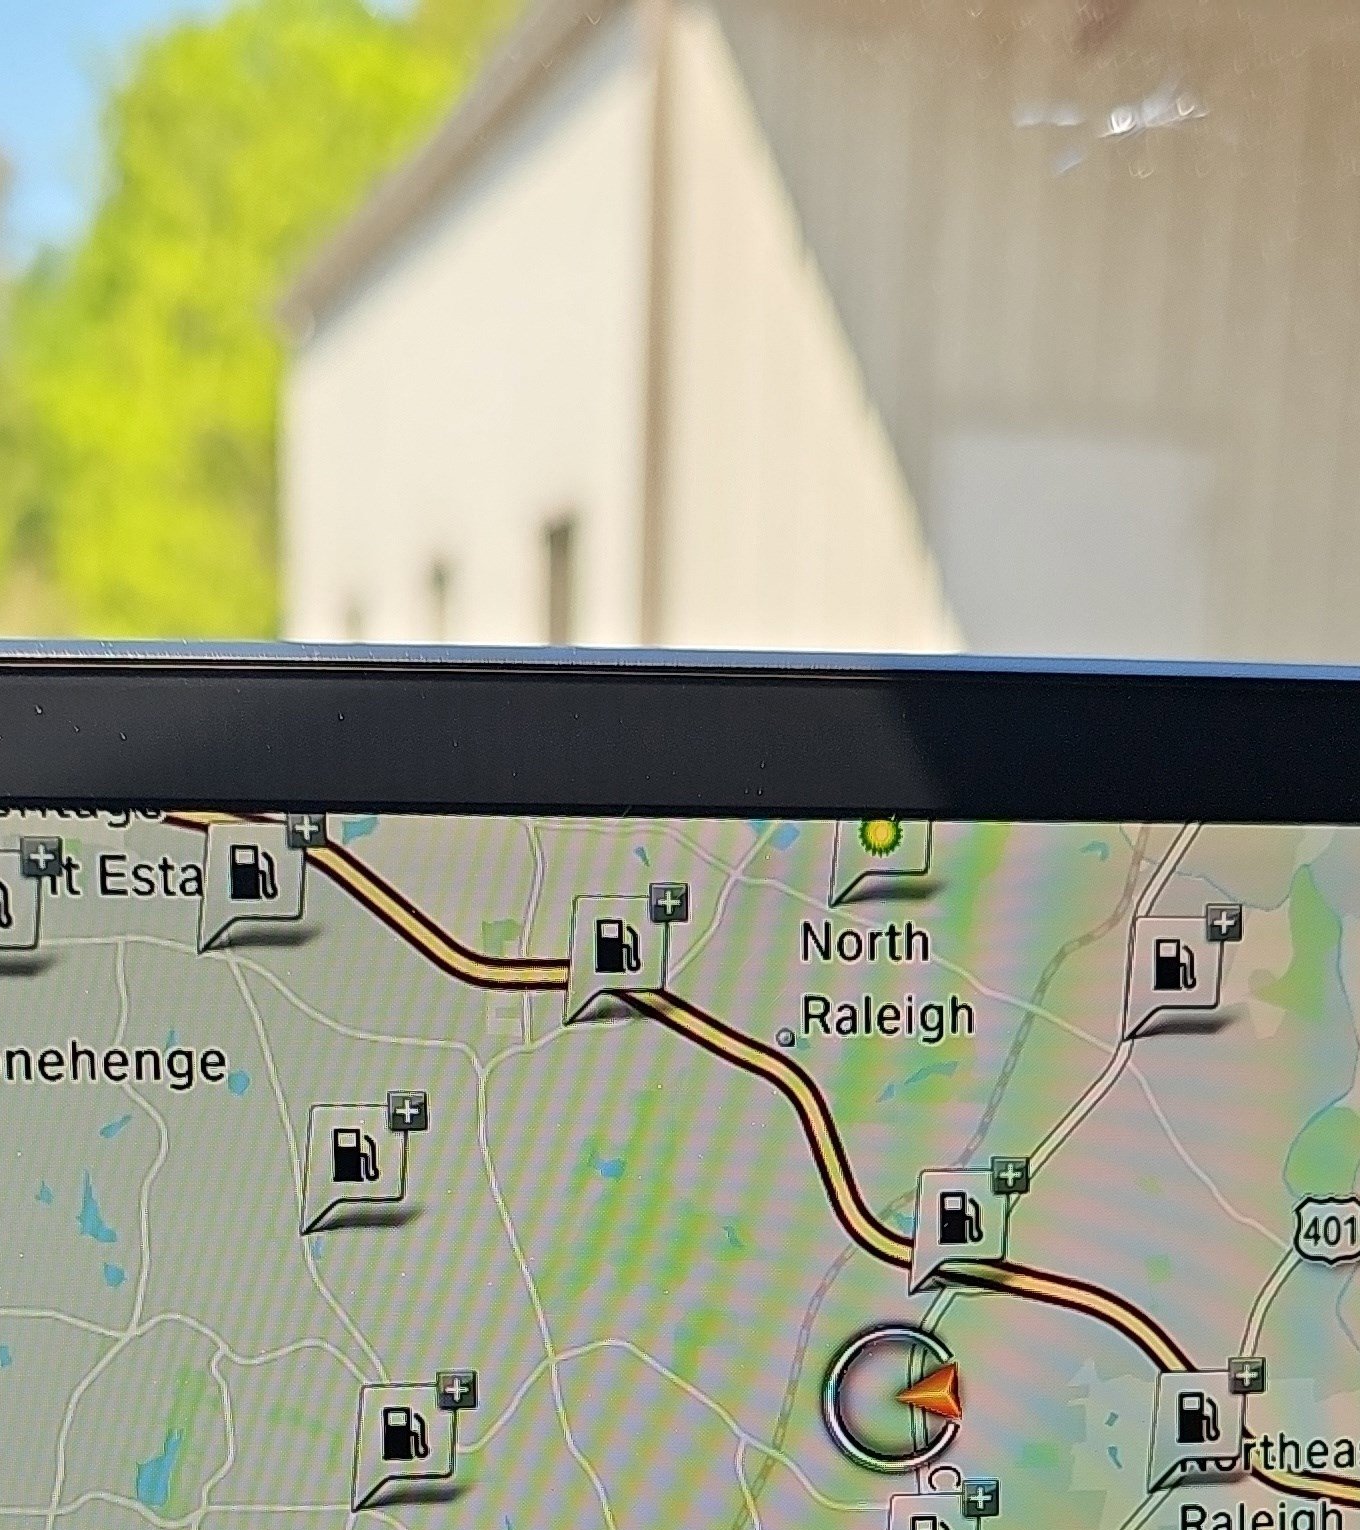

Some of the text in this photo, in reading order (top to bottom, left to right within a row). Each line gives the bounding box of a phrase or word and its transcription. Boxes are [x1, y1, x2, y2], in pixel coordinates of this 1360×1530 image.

[801, 920, 930, 962] North
[801, 994, 976, 1042] Raleigh
[1303, 1215, 1357, 1247] 401
